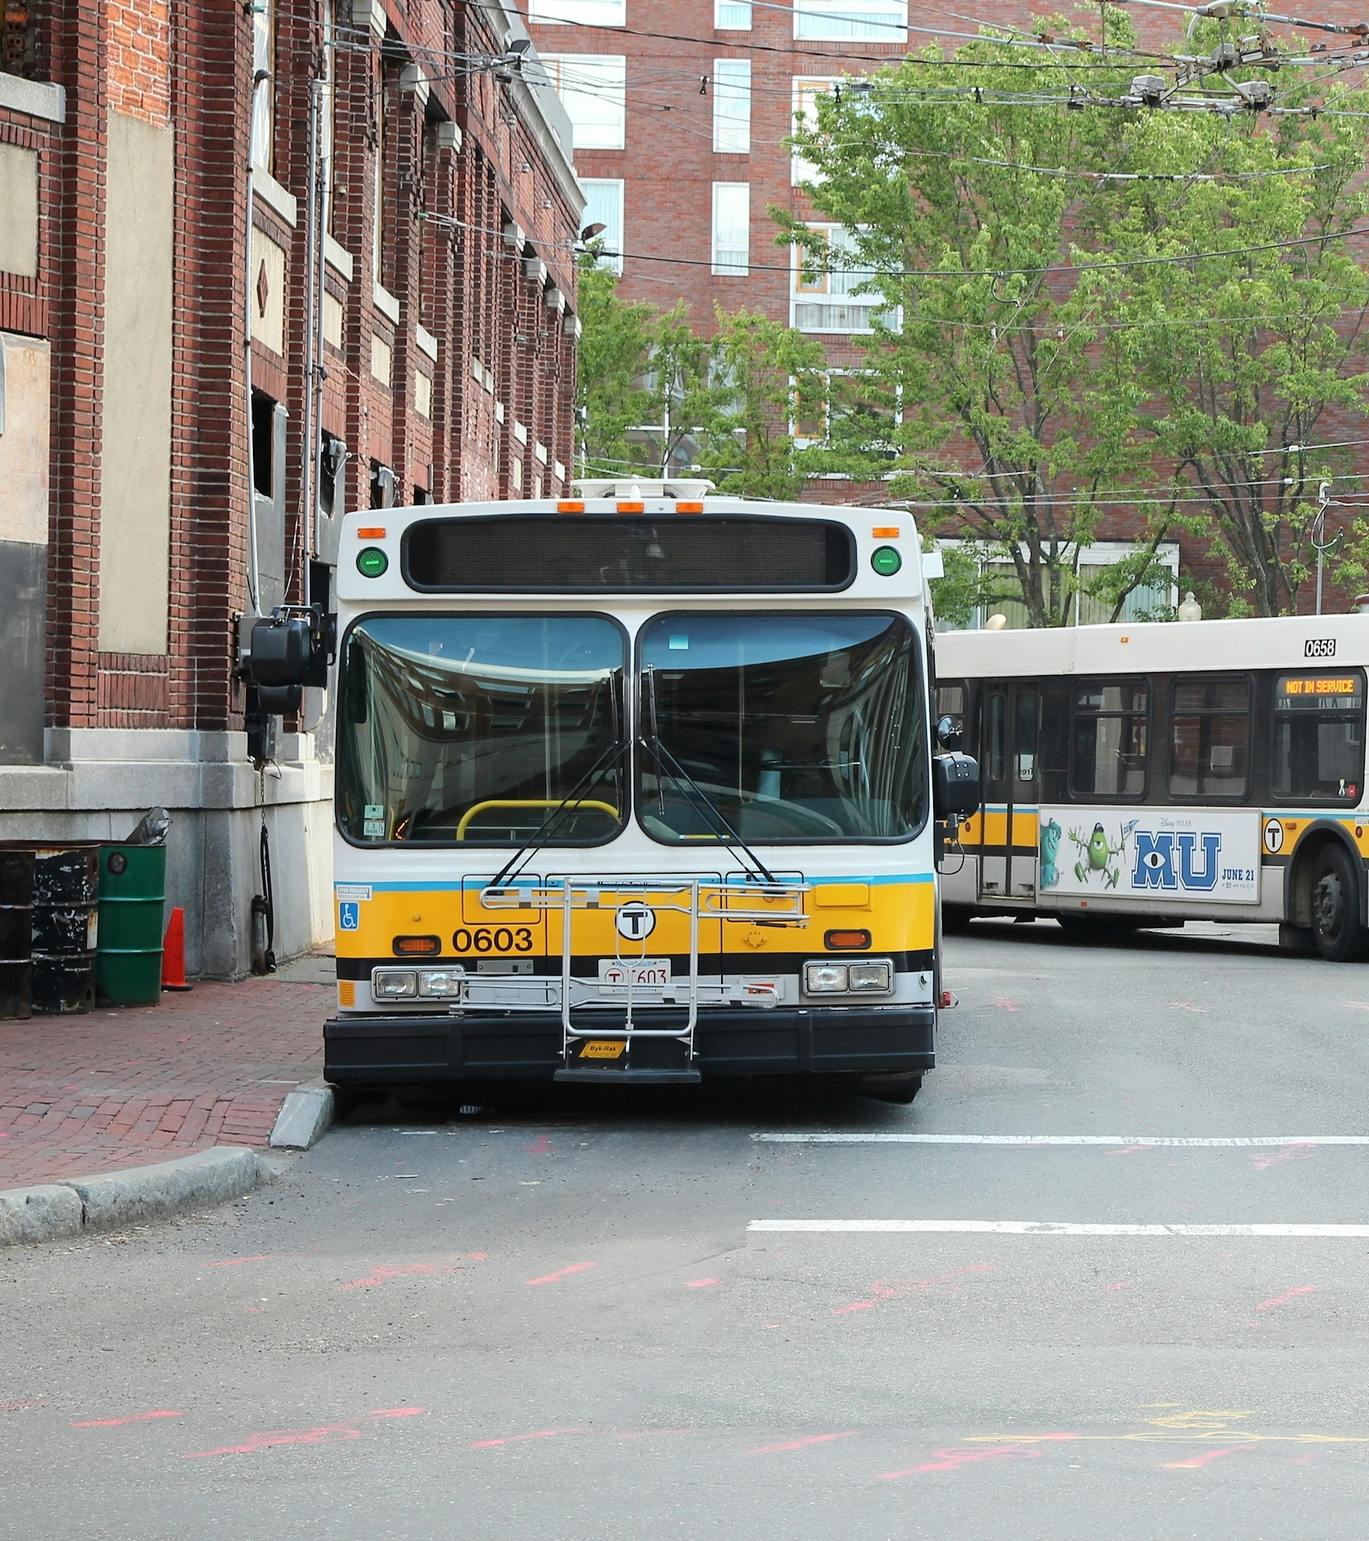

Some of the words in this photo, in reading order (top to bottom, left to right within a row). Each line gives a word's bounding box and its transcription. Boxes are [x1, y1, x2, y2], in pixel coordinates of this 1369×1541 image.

[1305, 639, 1335, 657] 0658
[1287, 680, 1304, 694] NOT
[1304, 680, 1315, 693] IN
[1316, 679, 1354, 694] SERVICE
[1131, 831, 1222, 892] MU
[1222, 868, 1244, 881] JUNE
[1245, 869, 1254, 881] 21
[622, 911, 648, 934] T
[452, 928, 533, 952] 0603
